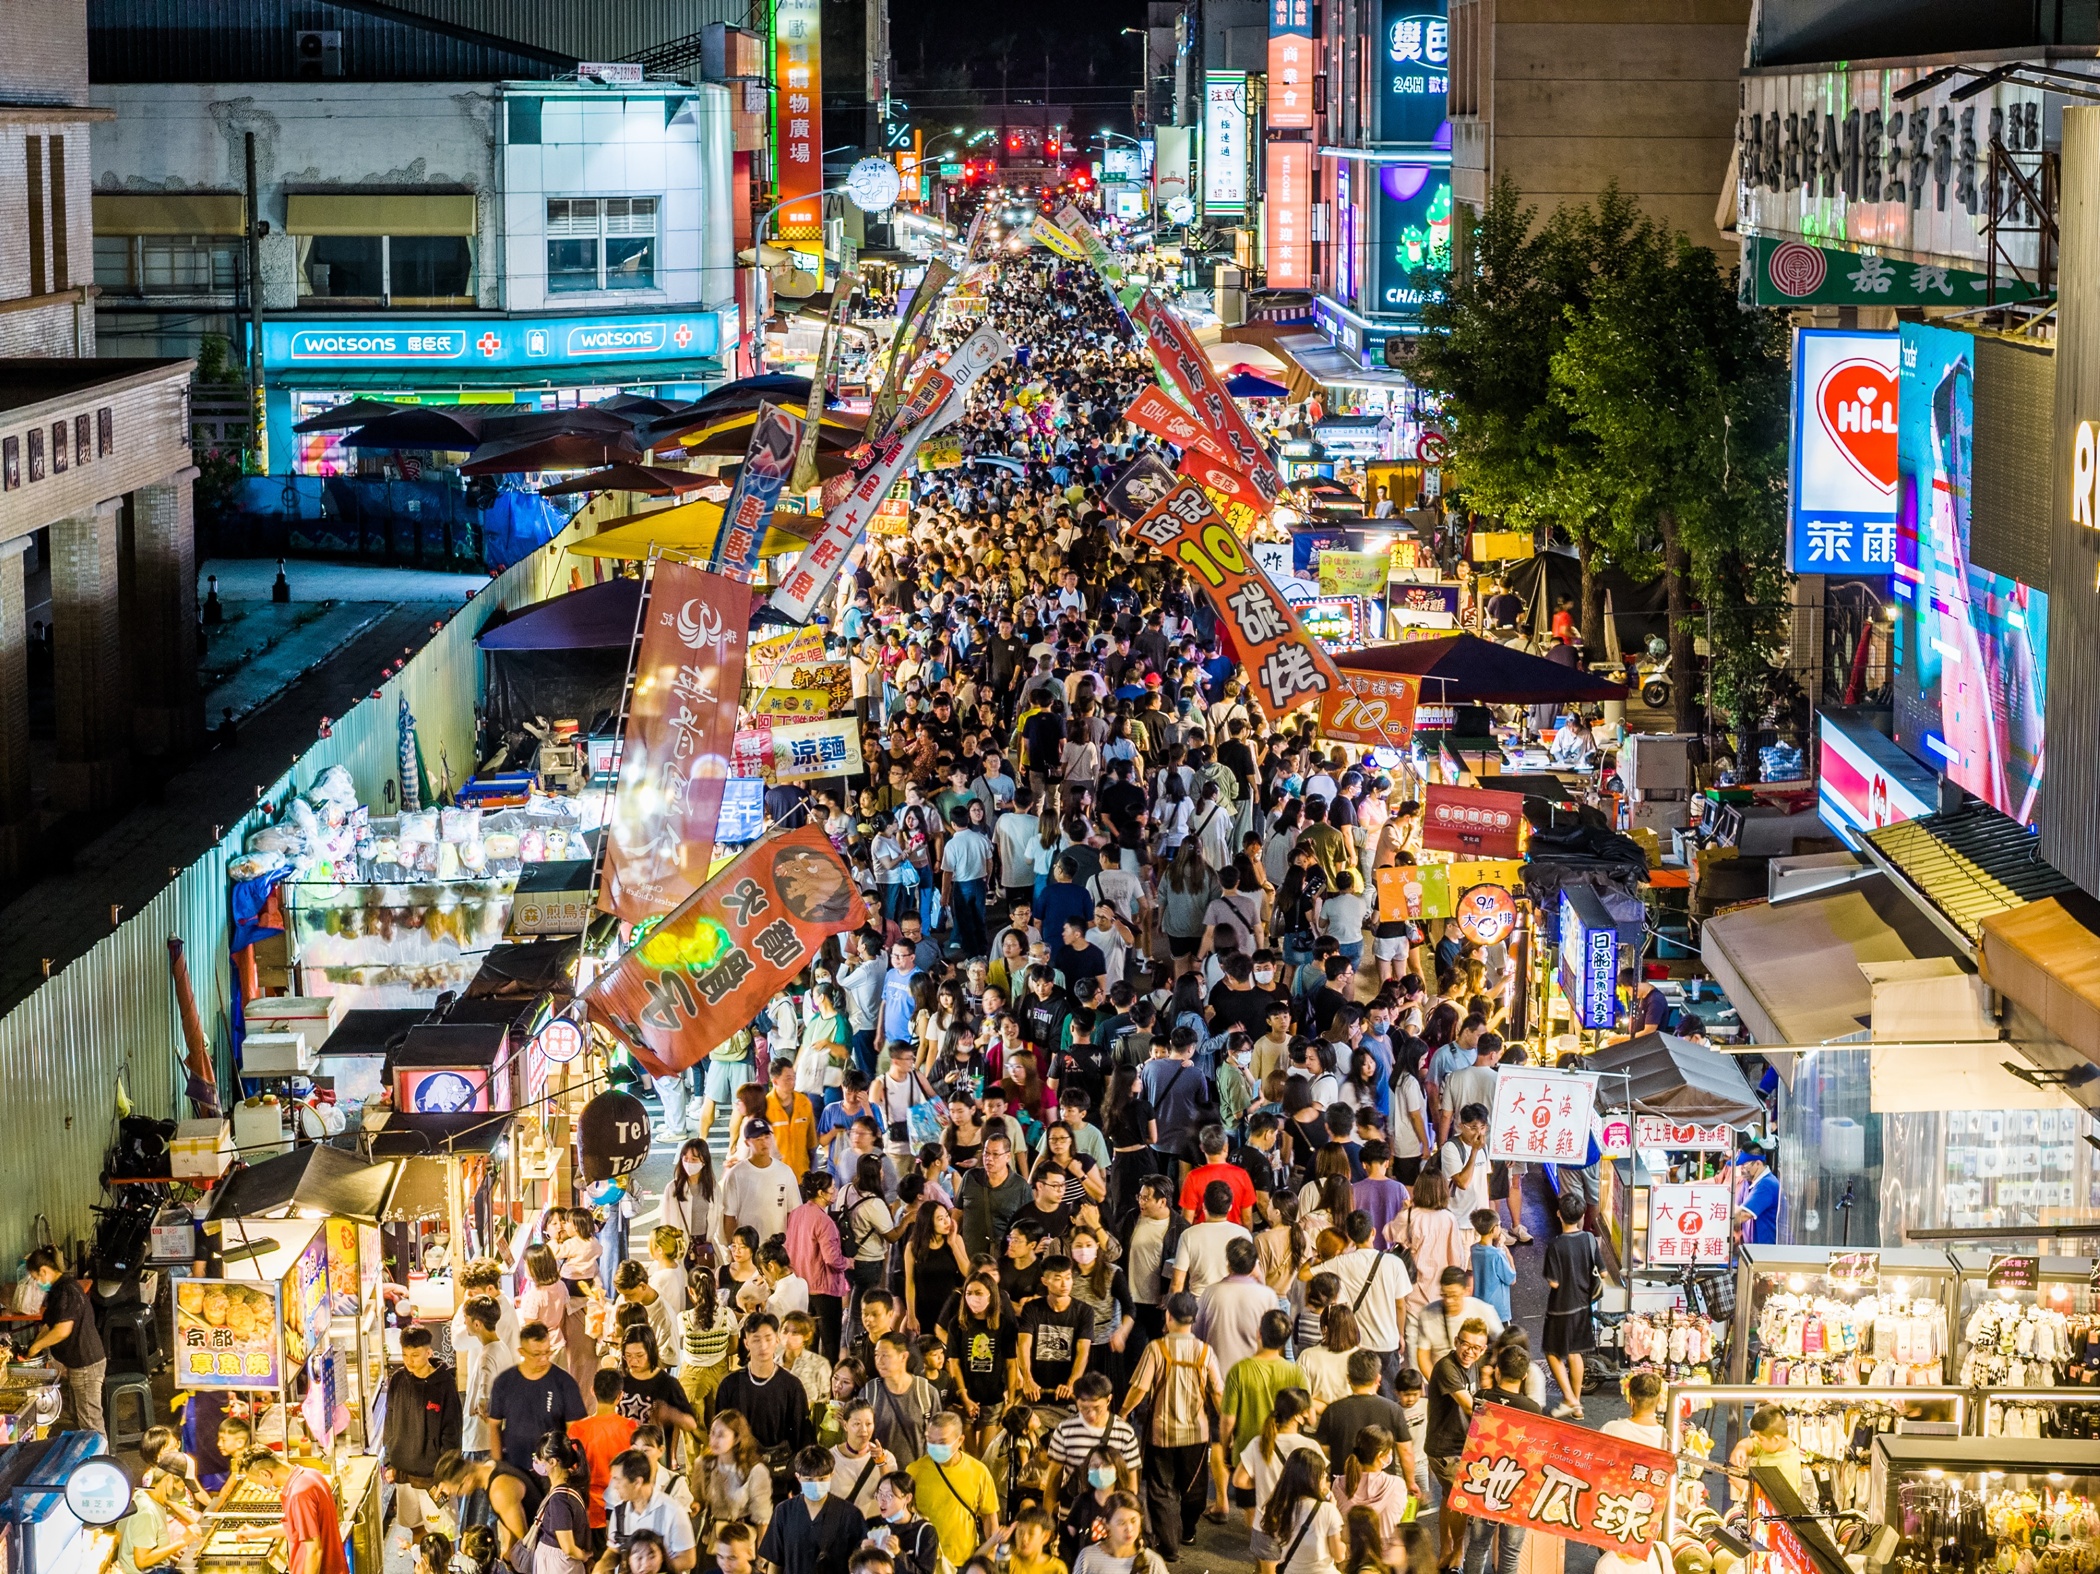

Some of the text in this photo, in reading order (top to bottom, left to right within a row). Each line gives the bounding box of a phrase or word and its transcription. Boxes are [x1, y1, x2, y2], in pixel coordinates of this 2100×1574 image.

[1394, 77, 1424, 93] 24H
[1282, 155, 1291, 202] WELCOME
[305, 336, 451, 352] watsons 屈臣氏
[581, 330, 653, 348] watsons
[1211, 472, 1235, 492] 老店
[2073, 421, 2100, 529] R
[884, 501, 900, 515] 味
[1138, 488, 1213, 546] 邱記
[1178, 524, 1247, 588] 10
[1263, 551, 1282, 571] 炸
[1228, 581, 1328, 708] 碳烤
[791, 667, 833, 688] 新疆
[1333, 697, 1389, 730] 10
[791, 735, 847, 767] 涼麵
[1381, 869, 1445, 885] 泰式奶茶
[1477, 869, 1501, 881] 手工
[1477, 896, 1495, 910] 94
[525, 908, 538, 922] 森
[1511, 1083, 1573, 1119] 大上海
[1501, 1125, 1574, 1156] 香酥雞
[1643, 1121, 1671, 1143] 大上海
[1656, 1190, 1727, 1222] 大上海
[1658, 1237, 1724, 1257] 香酥雞
[186, 1327, 234, 1347] 京都
[189, 1352, 271, 1376] 章魚燒
[1550, 1452, 1575, 1467] potato
[1575, 1459, 1592, 1471] balls
[1631, 1463, 1670, 1489] 素食
[1463, 1455, 1654, 1544] 地瓜球
